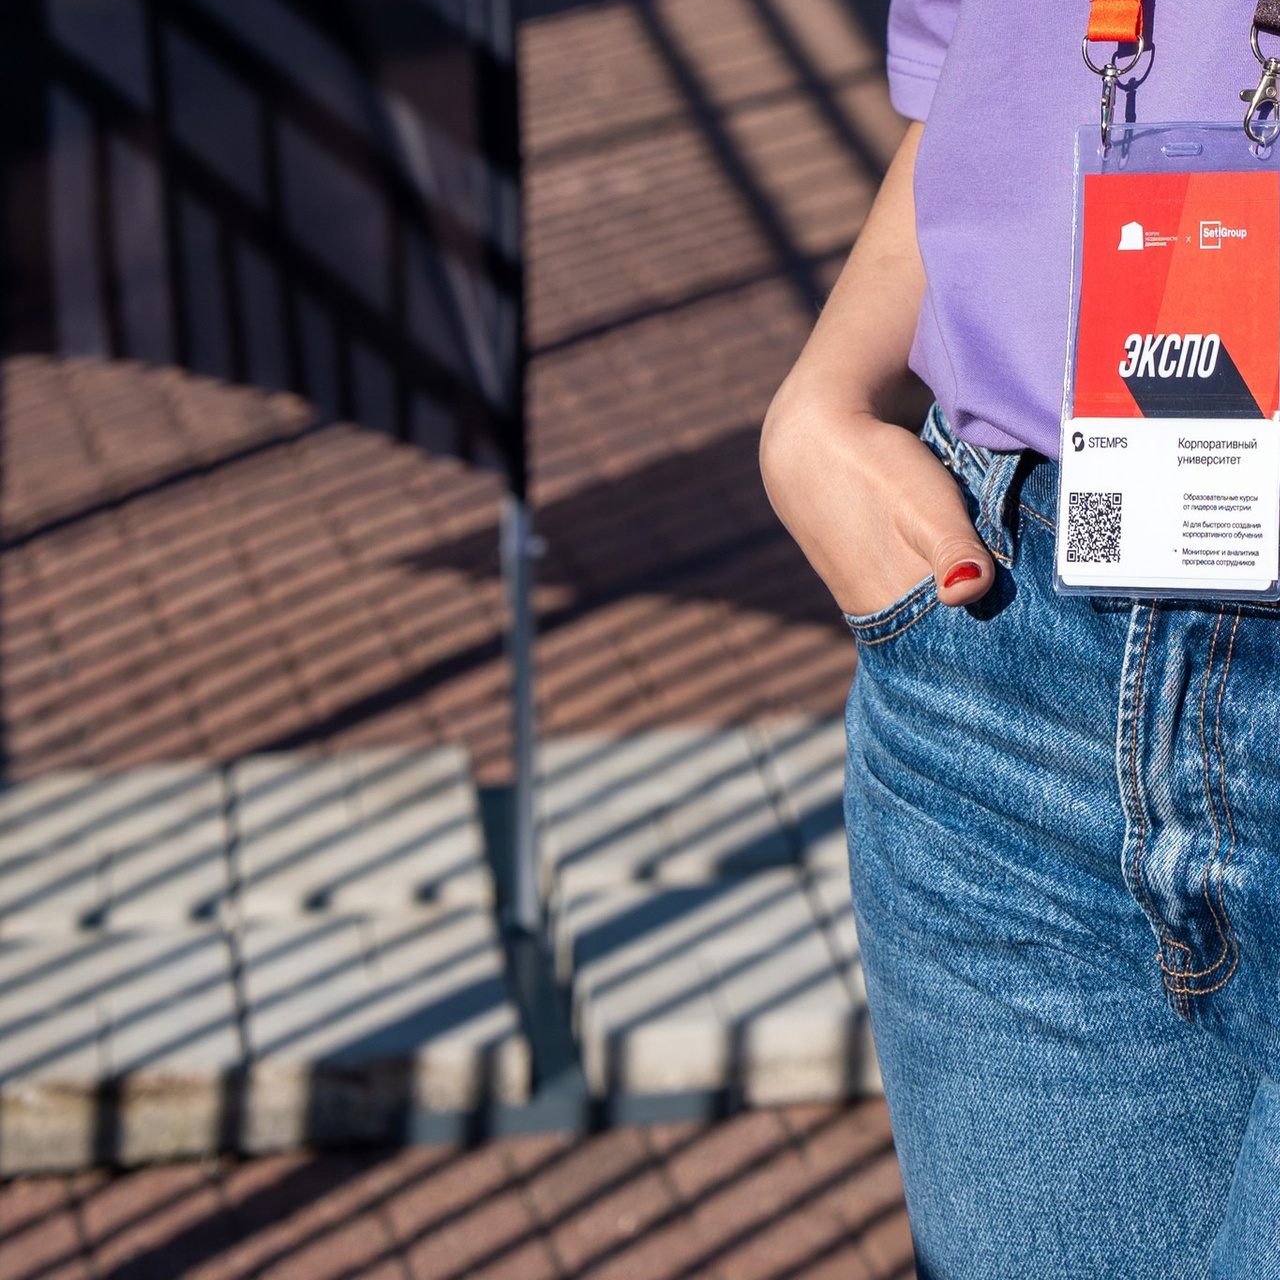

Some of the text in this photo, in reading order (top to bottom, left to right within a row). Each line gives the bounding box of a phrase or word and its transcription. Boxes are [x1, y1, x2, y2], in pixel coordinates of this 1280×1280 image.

[1118, 333, 1221, 378] ЭКСПО
[1088, 436, 1128, 449] STEMPS
[1177, 437, 1258, 451] Корпоративный
[1177, 454, 1241, 466] университет
[1183, 493, 1239, 502] Образовательные
[1191, 504, 1217, 512] лидеров
[1190, 521, 1202, 529] для
[1202, 521, 1231, 529] быстрого
[1182, 531, 1264, 539] корпоративного обучения
[1182, 547, 1220, 556] Мониторинг
[1182, 559, 1256, 567] прогресса сотрудников
